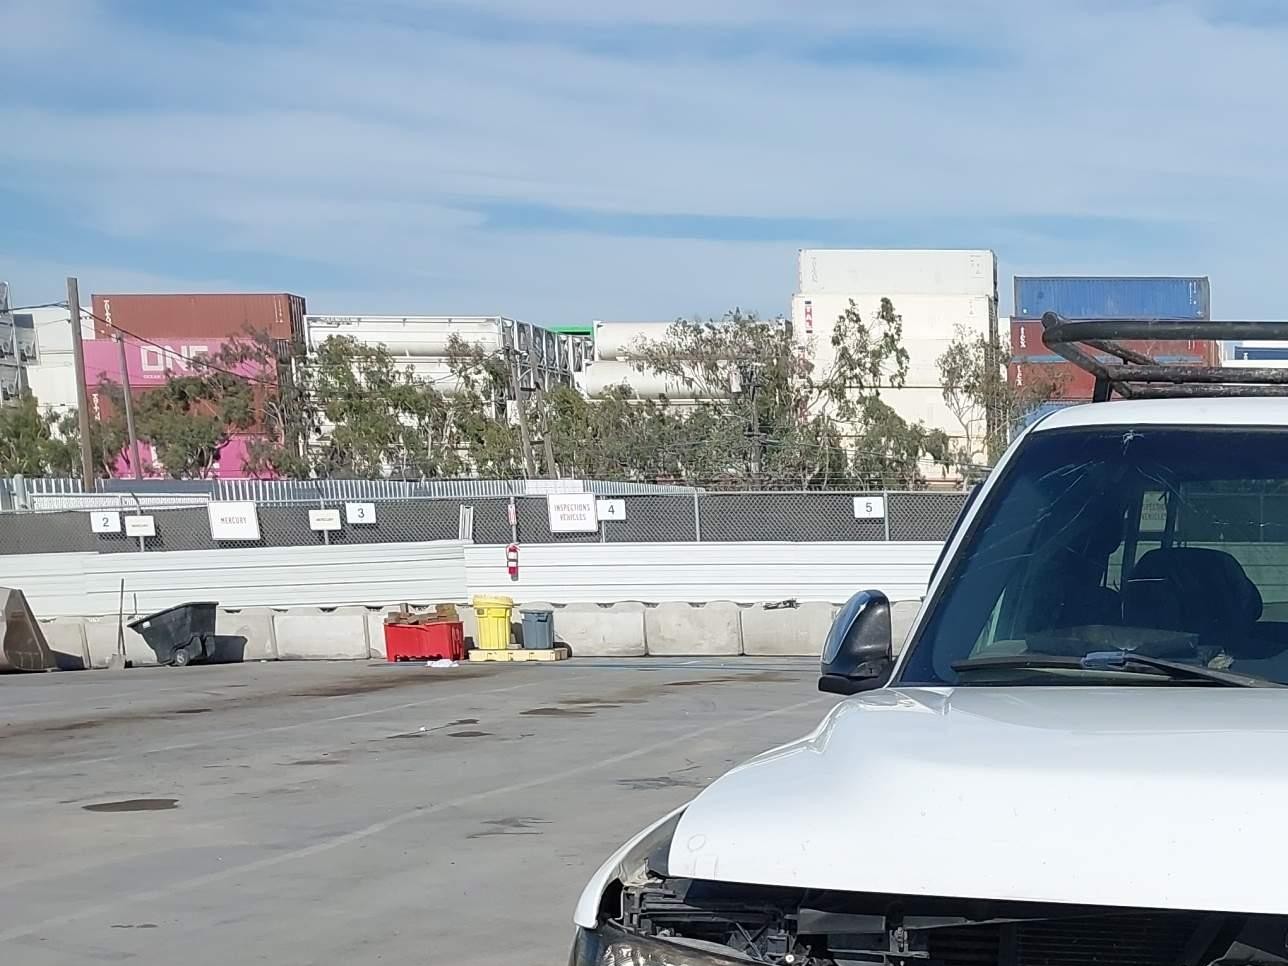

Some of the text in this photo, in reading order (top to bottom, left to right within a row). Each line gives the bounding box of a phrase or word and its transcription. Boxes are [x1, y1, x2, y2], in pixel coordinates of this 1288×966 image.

[554, 503, 590, 512] INSPECTIONS
[608, 505, 615, 515] 4
[865, 502, 873, 513] 5
[357, 508, 365, 519] 3
[102, 517, 110, 528] 2
